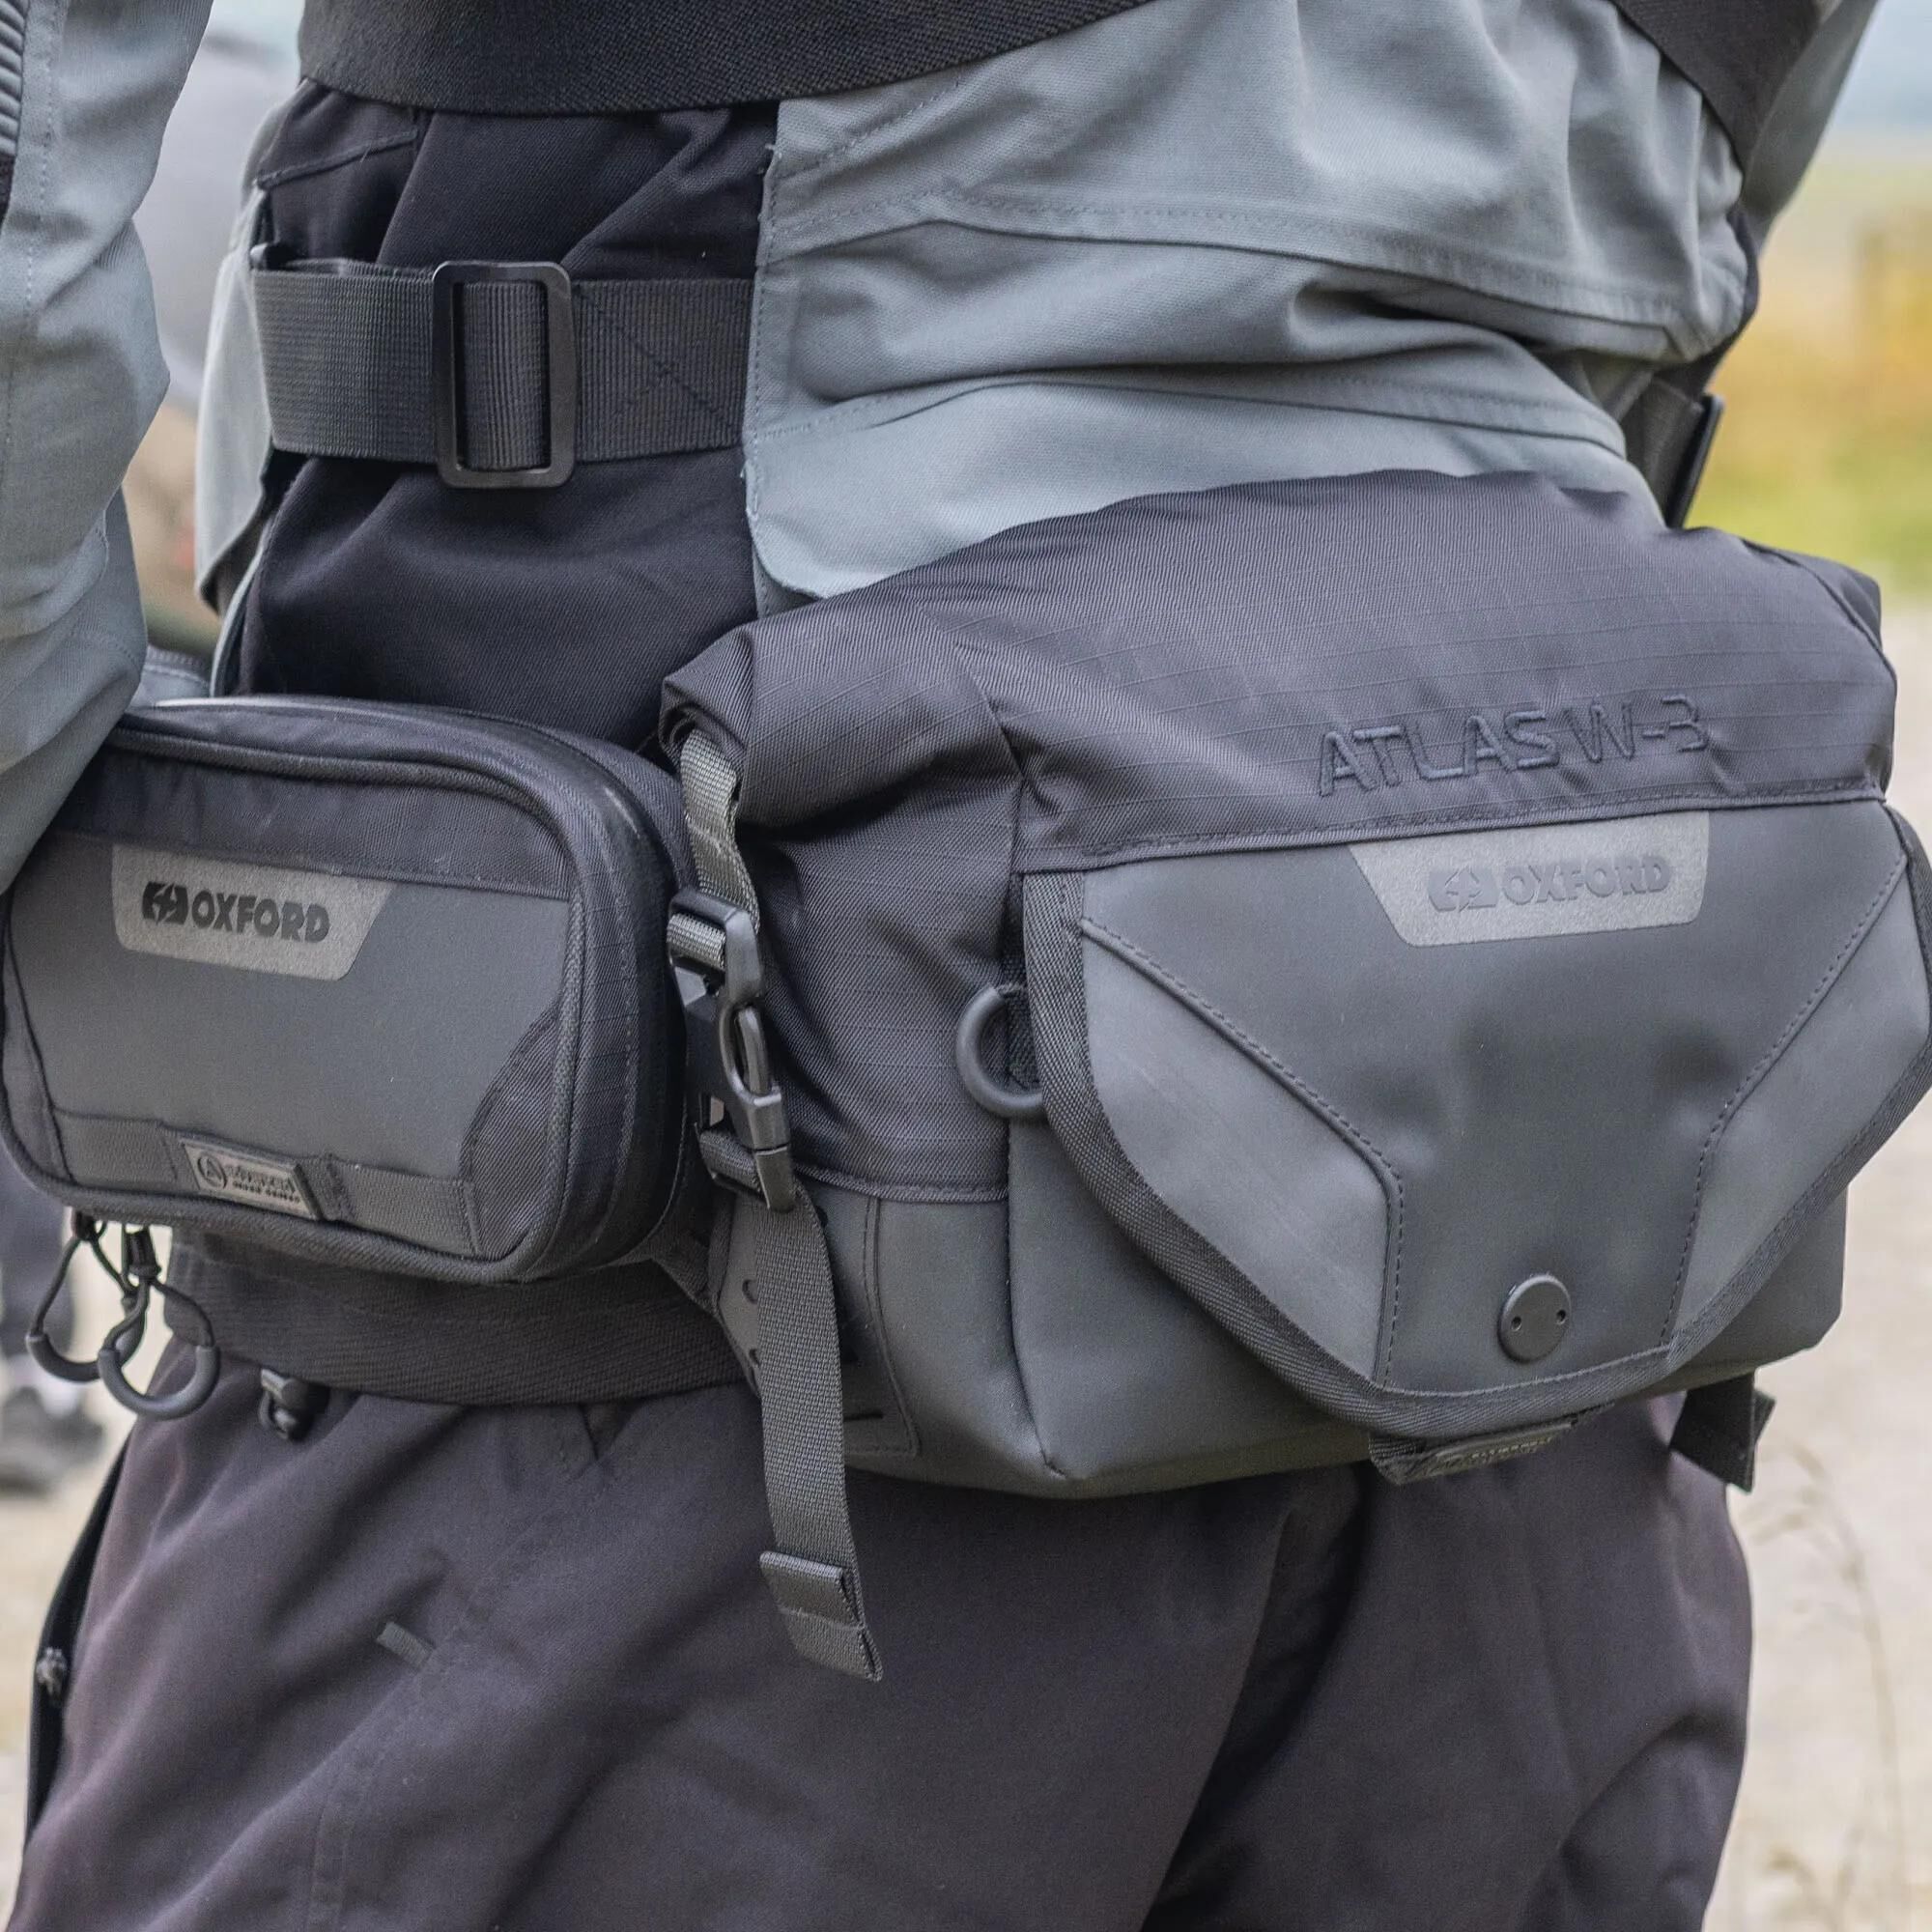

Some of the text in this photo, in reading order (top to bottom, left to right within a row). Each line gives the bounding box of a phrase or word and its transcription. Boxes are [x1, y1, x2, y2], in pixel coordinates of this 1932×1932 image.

[1320, 694, 1710, 797] ATLAS W-3
[1501, 853, 1671, 905] OXFORD
[191, 890, 330, 944] OXFORD
